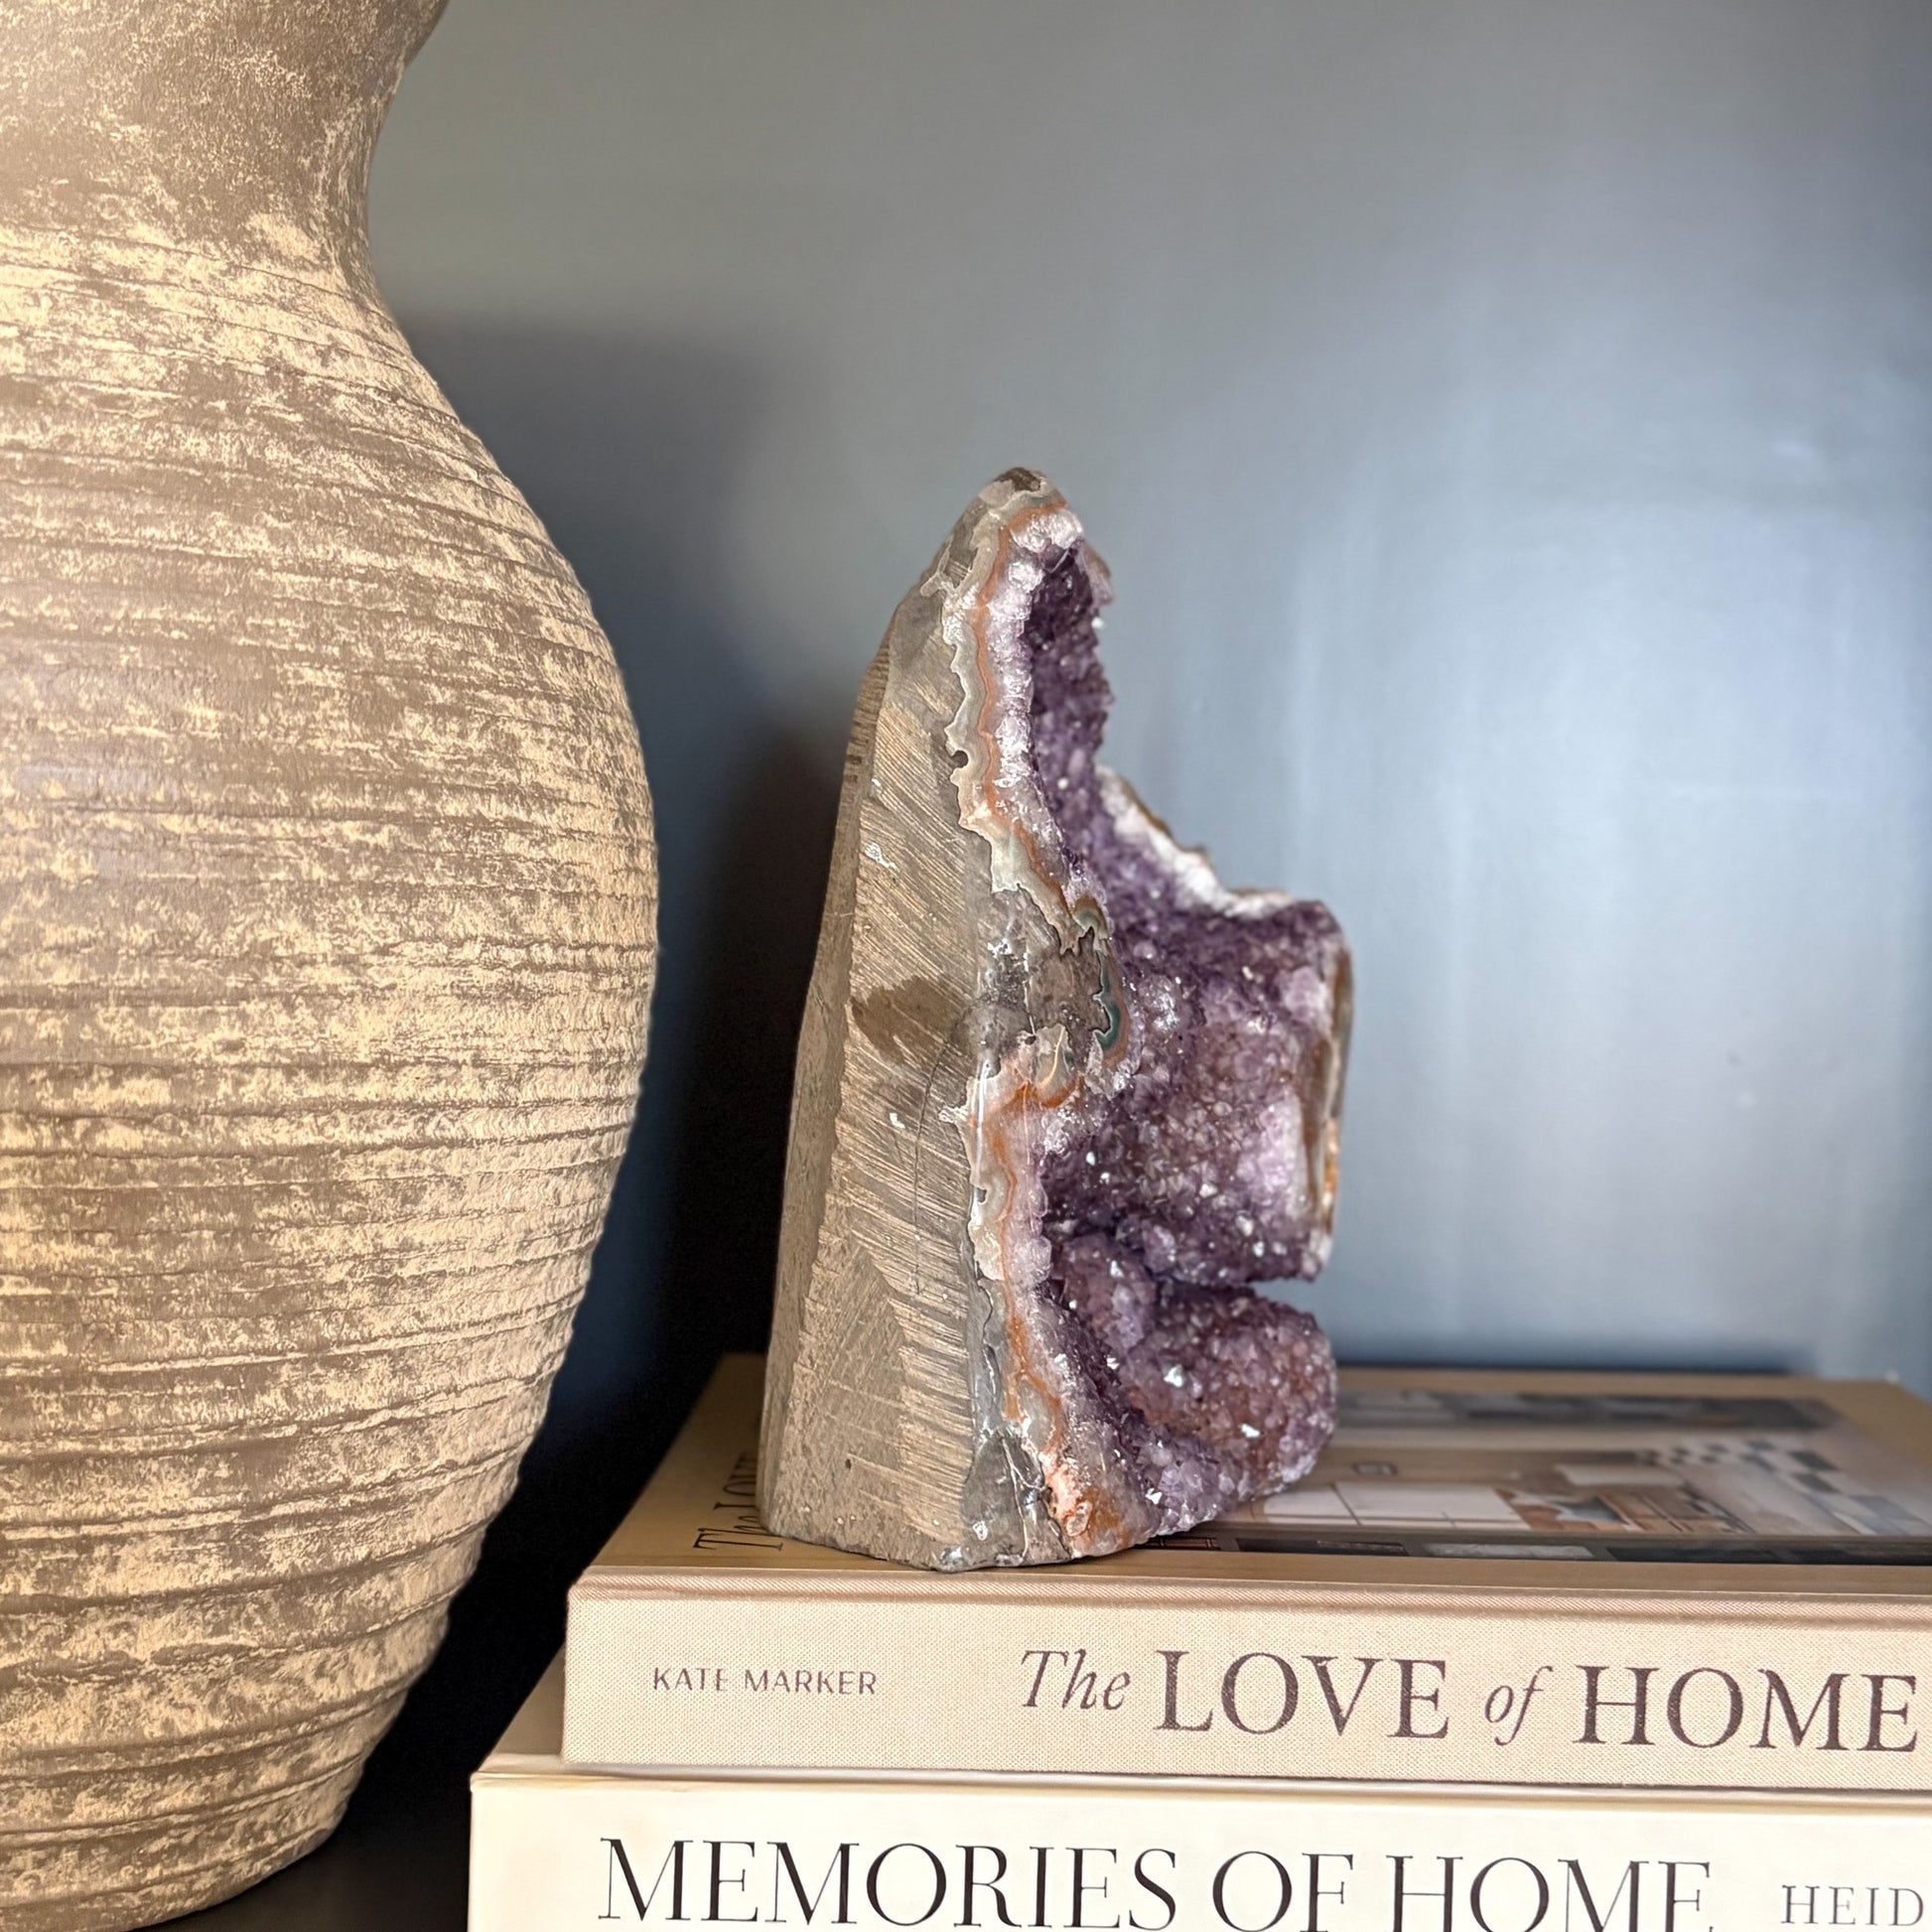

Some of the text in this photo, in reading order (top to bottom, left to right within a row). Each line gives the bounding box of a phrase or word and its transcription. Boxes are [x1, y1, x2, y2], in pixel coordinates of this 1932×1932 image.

[653, 1667, 877, 1695] KATE MARKER
[1022, 1649, 1918, 1752] The LOVE of HOME
[598, 1838, 1712, 1932] MEMORIES OF HOME
[1781, 1884, 1924, 1926] HEID
